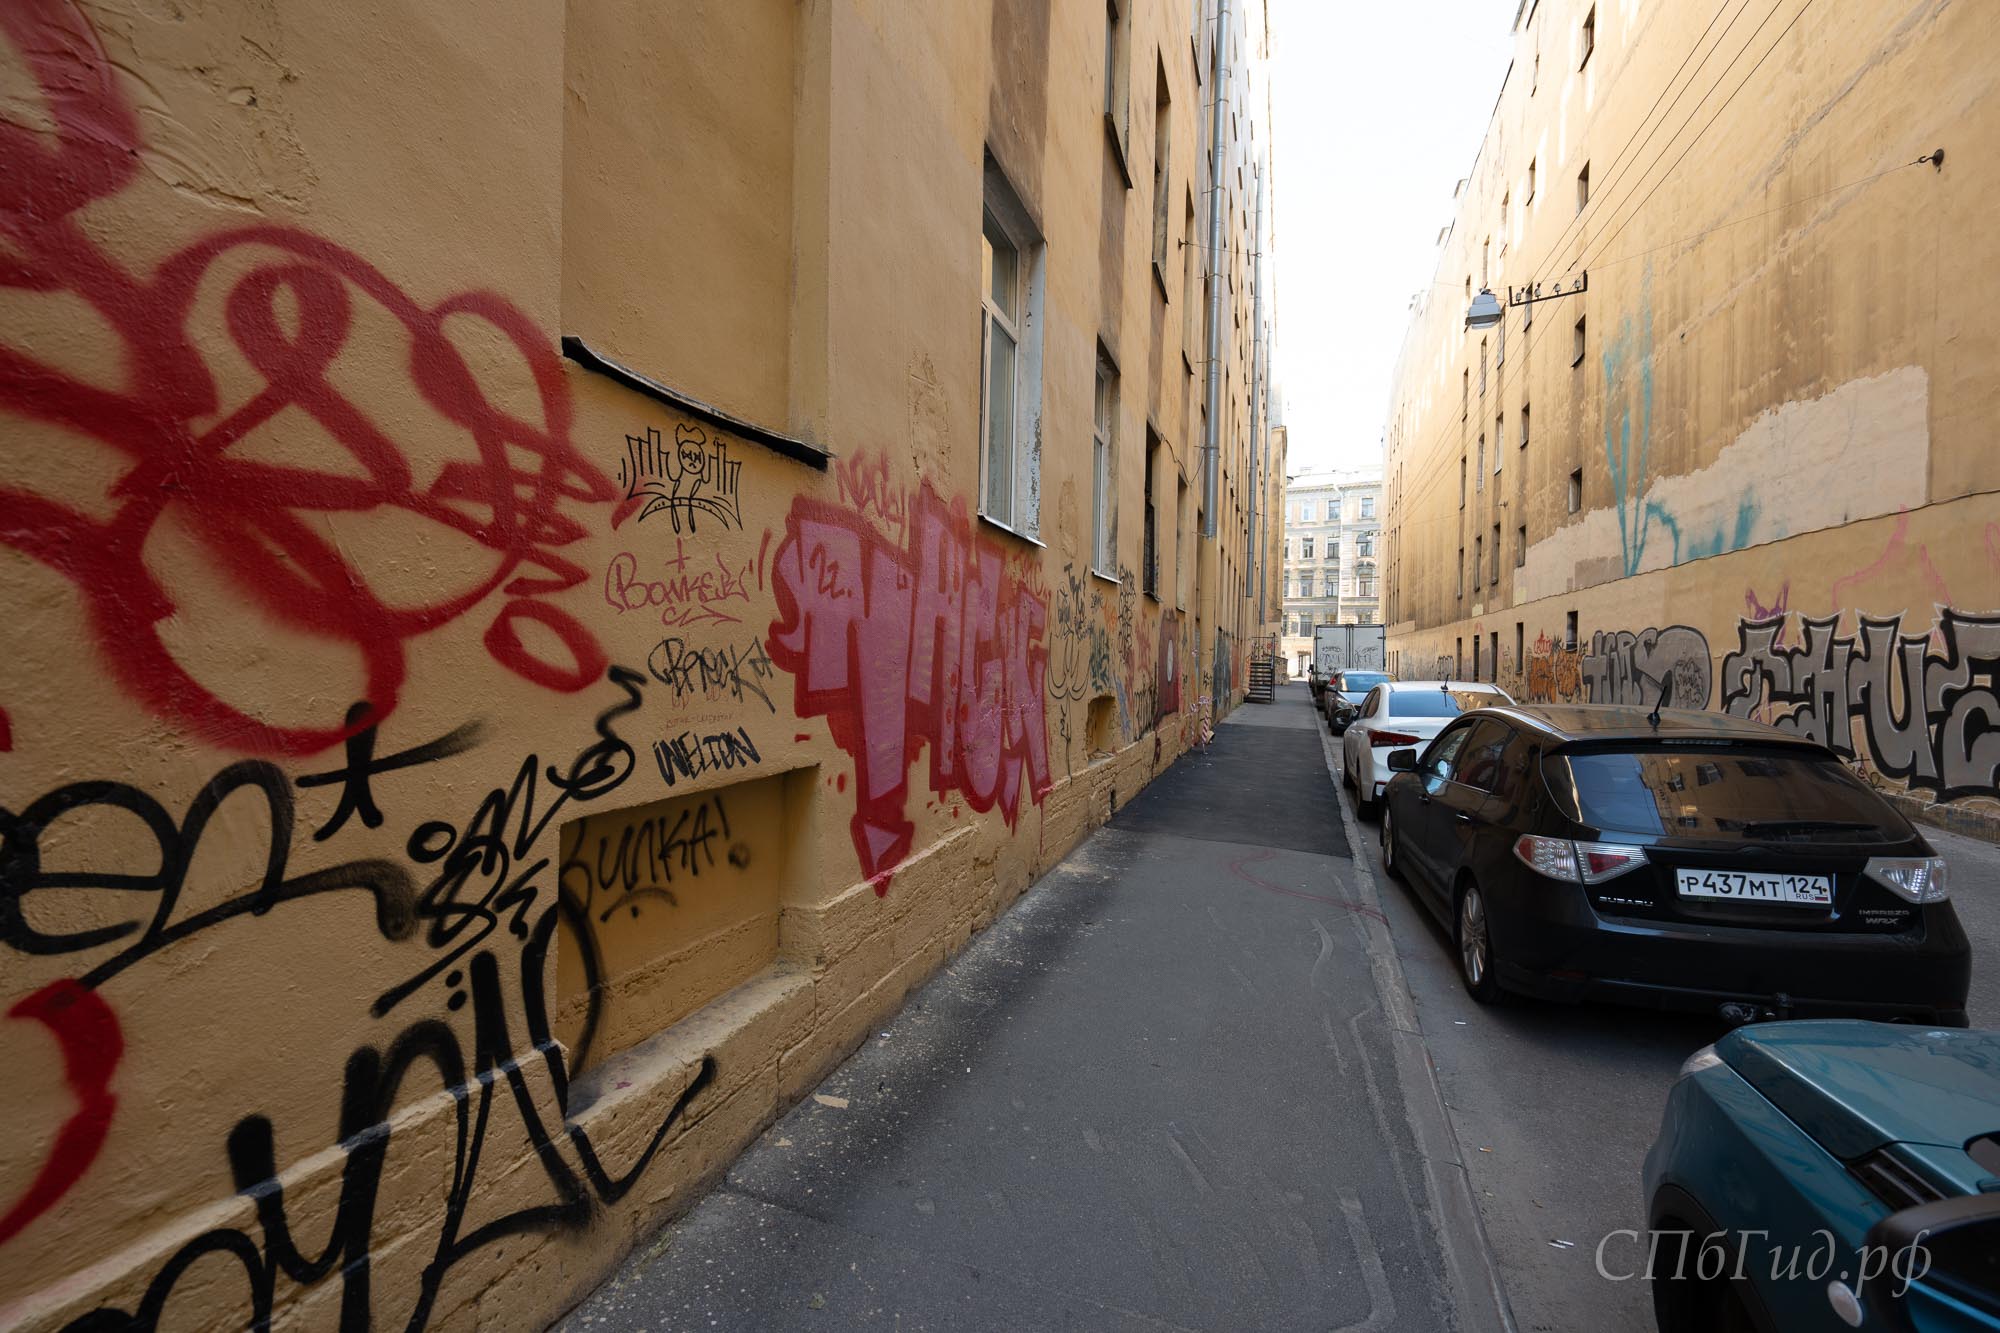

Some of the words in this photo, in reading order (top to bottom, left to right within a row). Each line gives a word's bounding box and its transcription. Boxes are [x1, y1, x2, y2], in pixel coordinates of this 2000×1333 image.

[1786, 876, 1823, 895] 124
[1795, 893, 1815, 901] RUS
[1865, 917, 1899, 925] WRX
